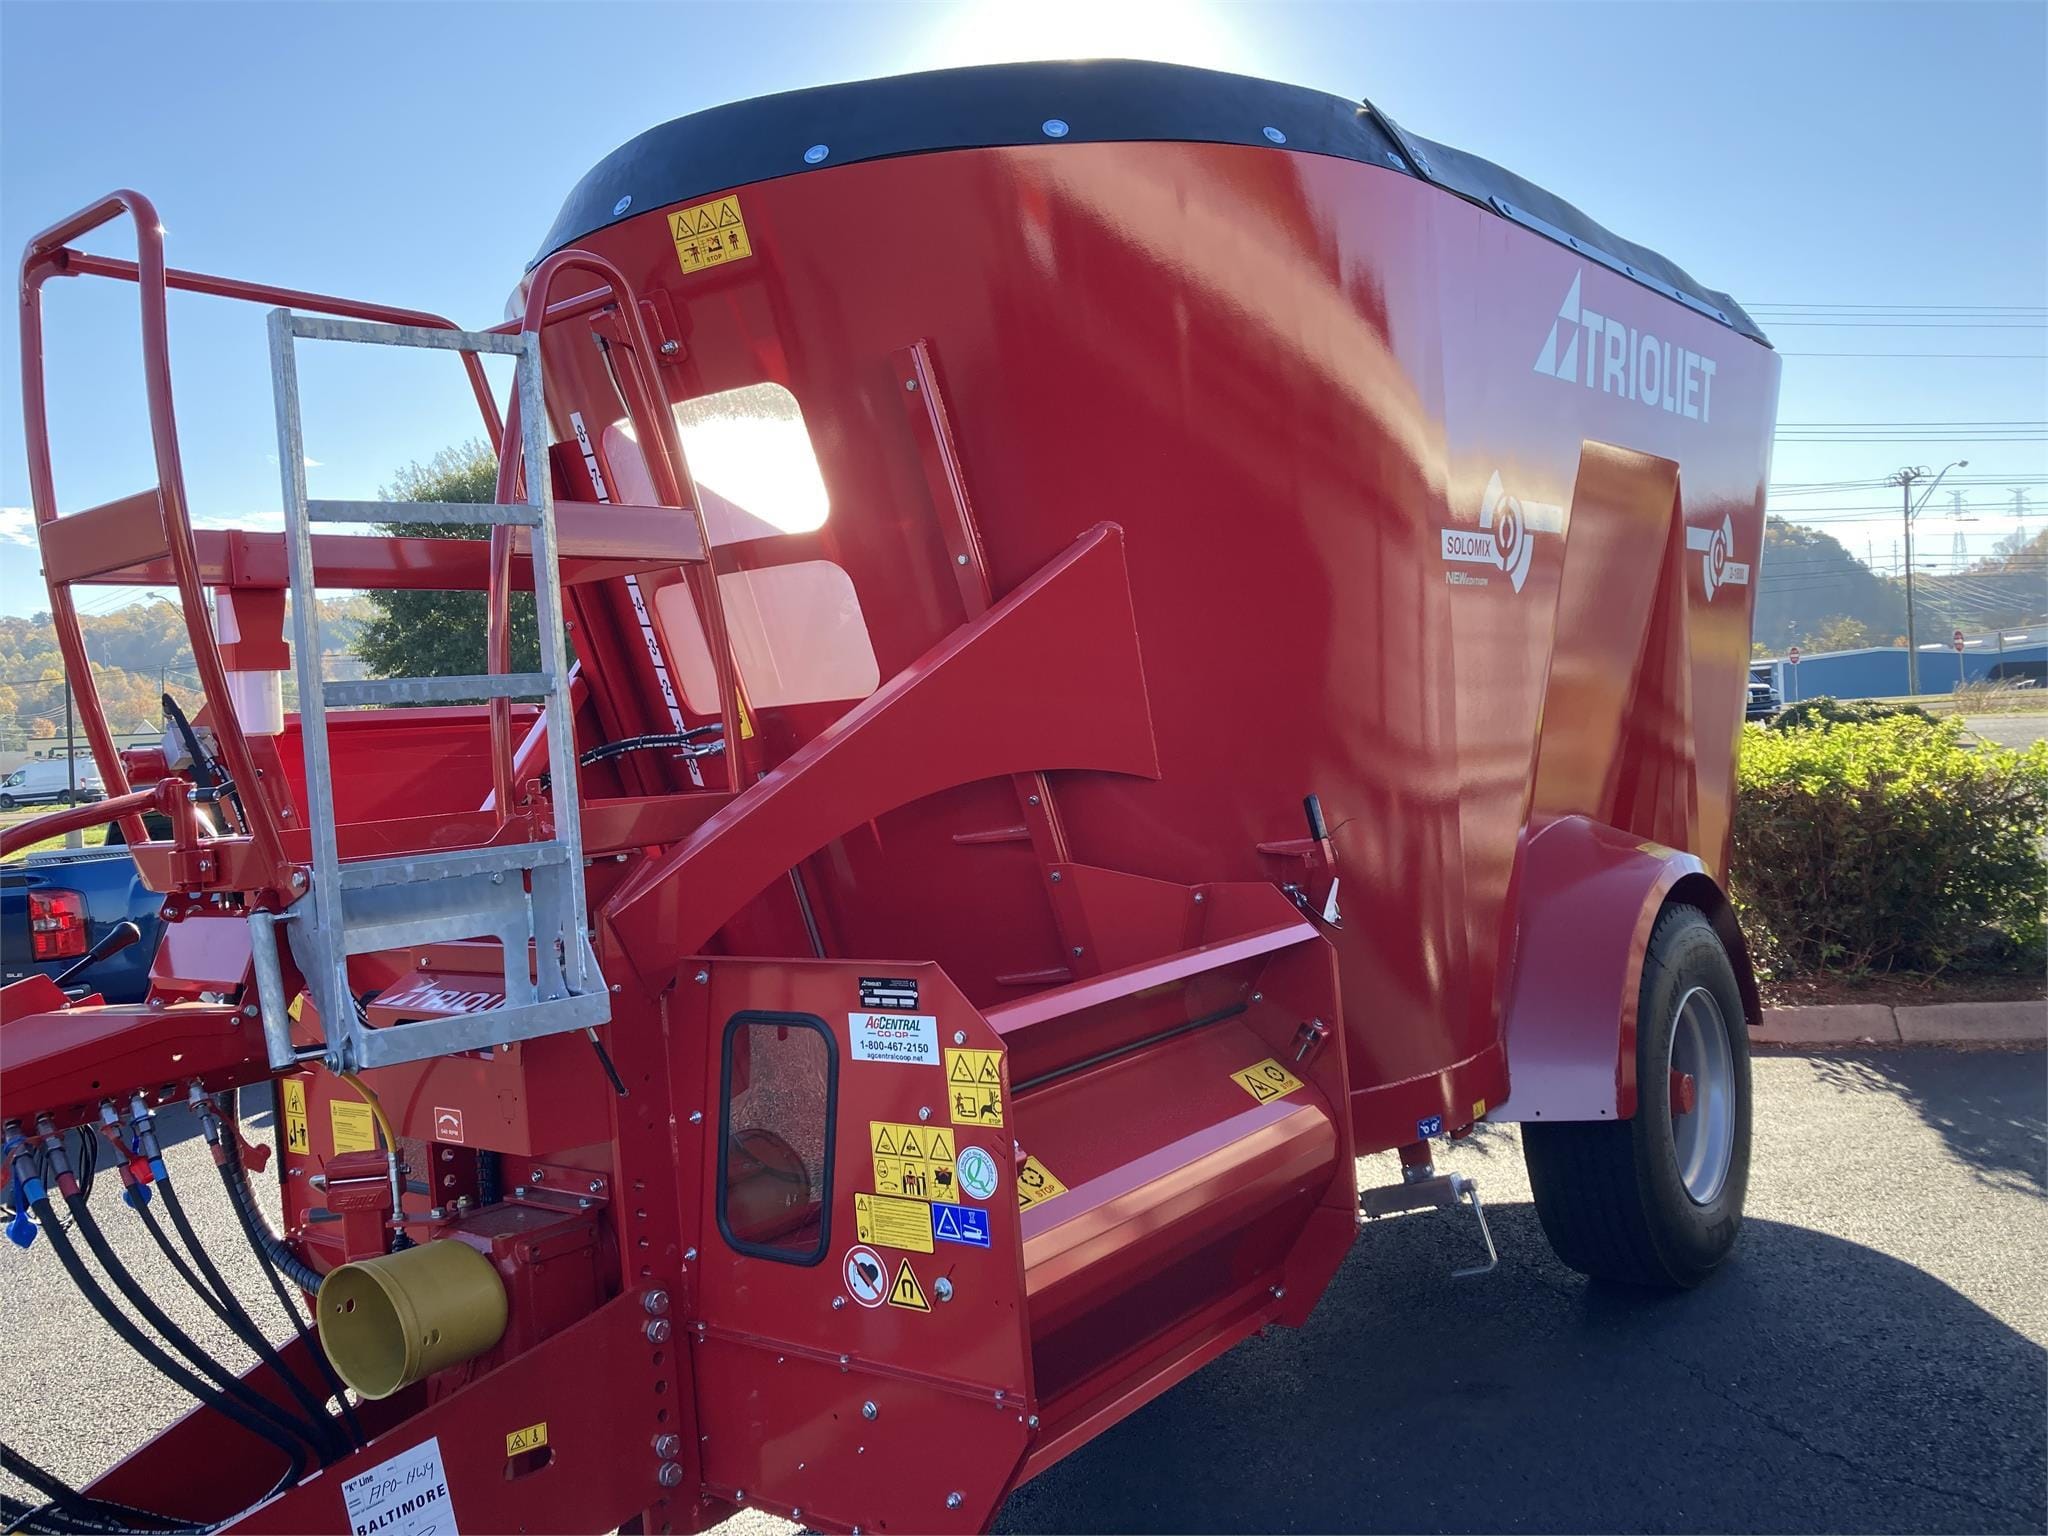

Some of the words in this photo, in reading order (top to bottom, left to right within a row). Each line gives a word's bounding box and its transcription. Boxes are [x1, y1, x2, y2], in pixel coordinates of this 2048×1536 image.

[706, 253, 723, 263] STOP
[1581, 308, 1717, 423] TRIOLIET
[576, 425, 586, 443] 8
[591, 468, 600, 486] 7
[1447, 536, 1491, 558] SOLOMIX
[635, 596, 644, 614] 4
[648, 638, 658, 656] 3
[662, 679, 672, 696] 2
[877, 1030, 909, 1039] CO-OP
[860, 1040, 929, 1053] 1-800-467-2150
[867, 1053, 924, 1062] agcentralcoop.net
[1035, 1184, 1055, 1198] STOP
[344, 1481, 358, 1493] "K"
[359, 1475, 374, 1487] Line
[357, 1483, 447, 1536] BALTIMORE
